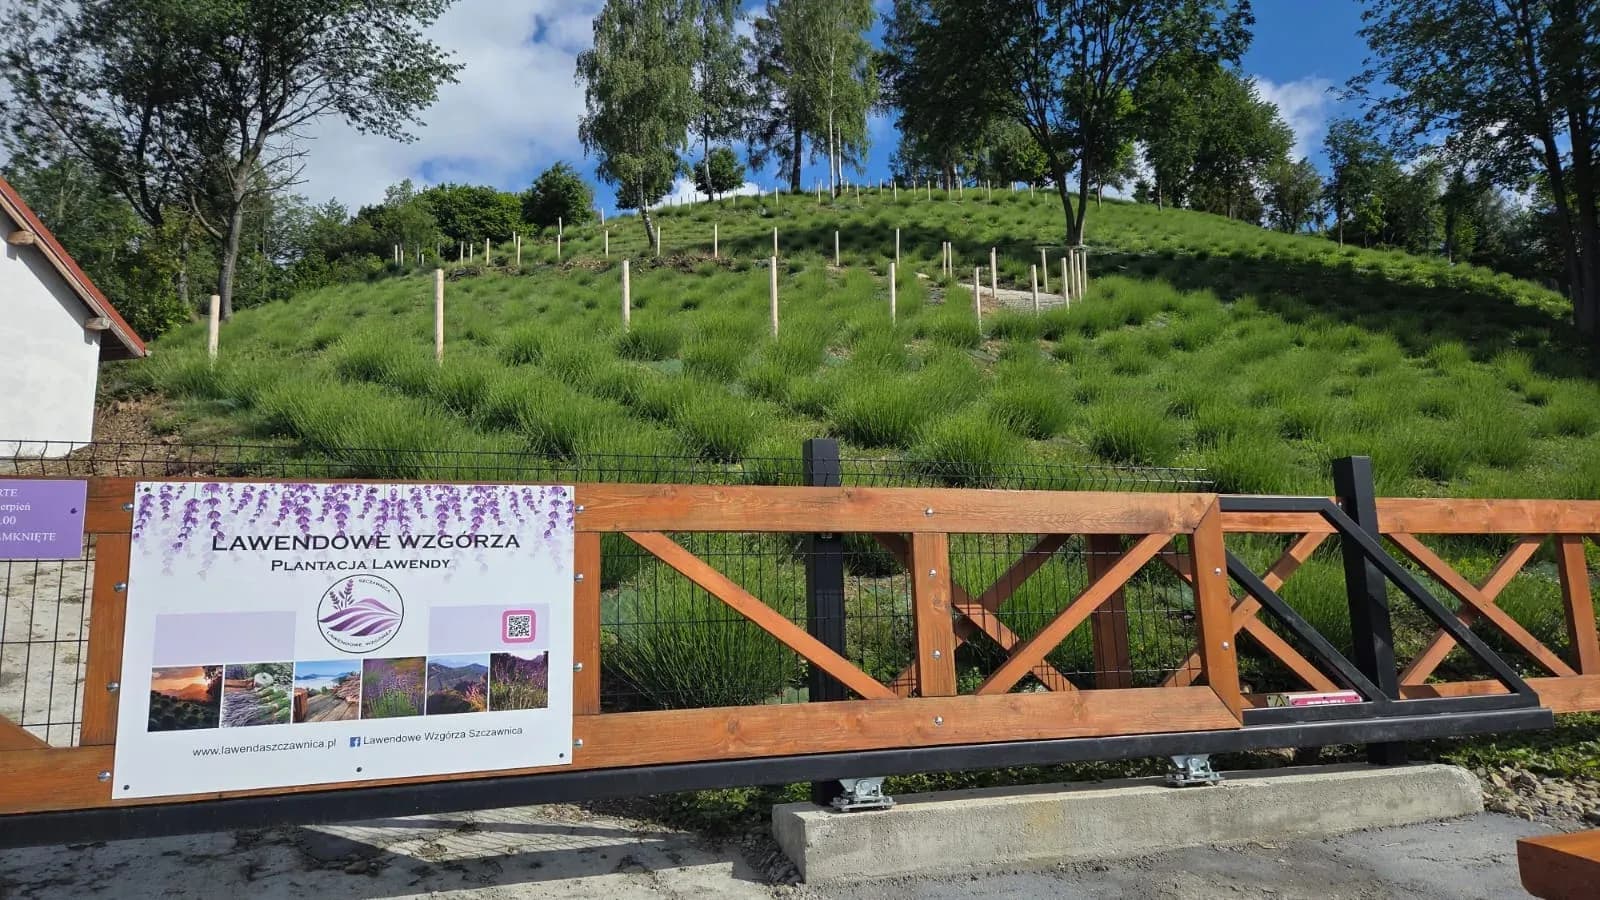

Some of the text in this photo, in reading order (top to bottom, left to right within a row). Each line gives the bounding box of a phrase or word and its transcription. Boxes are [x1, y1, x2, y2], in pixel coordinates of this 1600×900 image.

[0, 532, 57, 543] MKNIĘTE
[212, 531, 520, 551] LAWENDOWE WZGÓRZA
[363, 734, 422, 745] Lawendowe
[424, 730, 466, 742] Wzgórza
[468, 726, 523, 738] Szczawnica
[192, 738, 337, 757] www.lawendaszczawnica.pl
